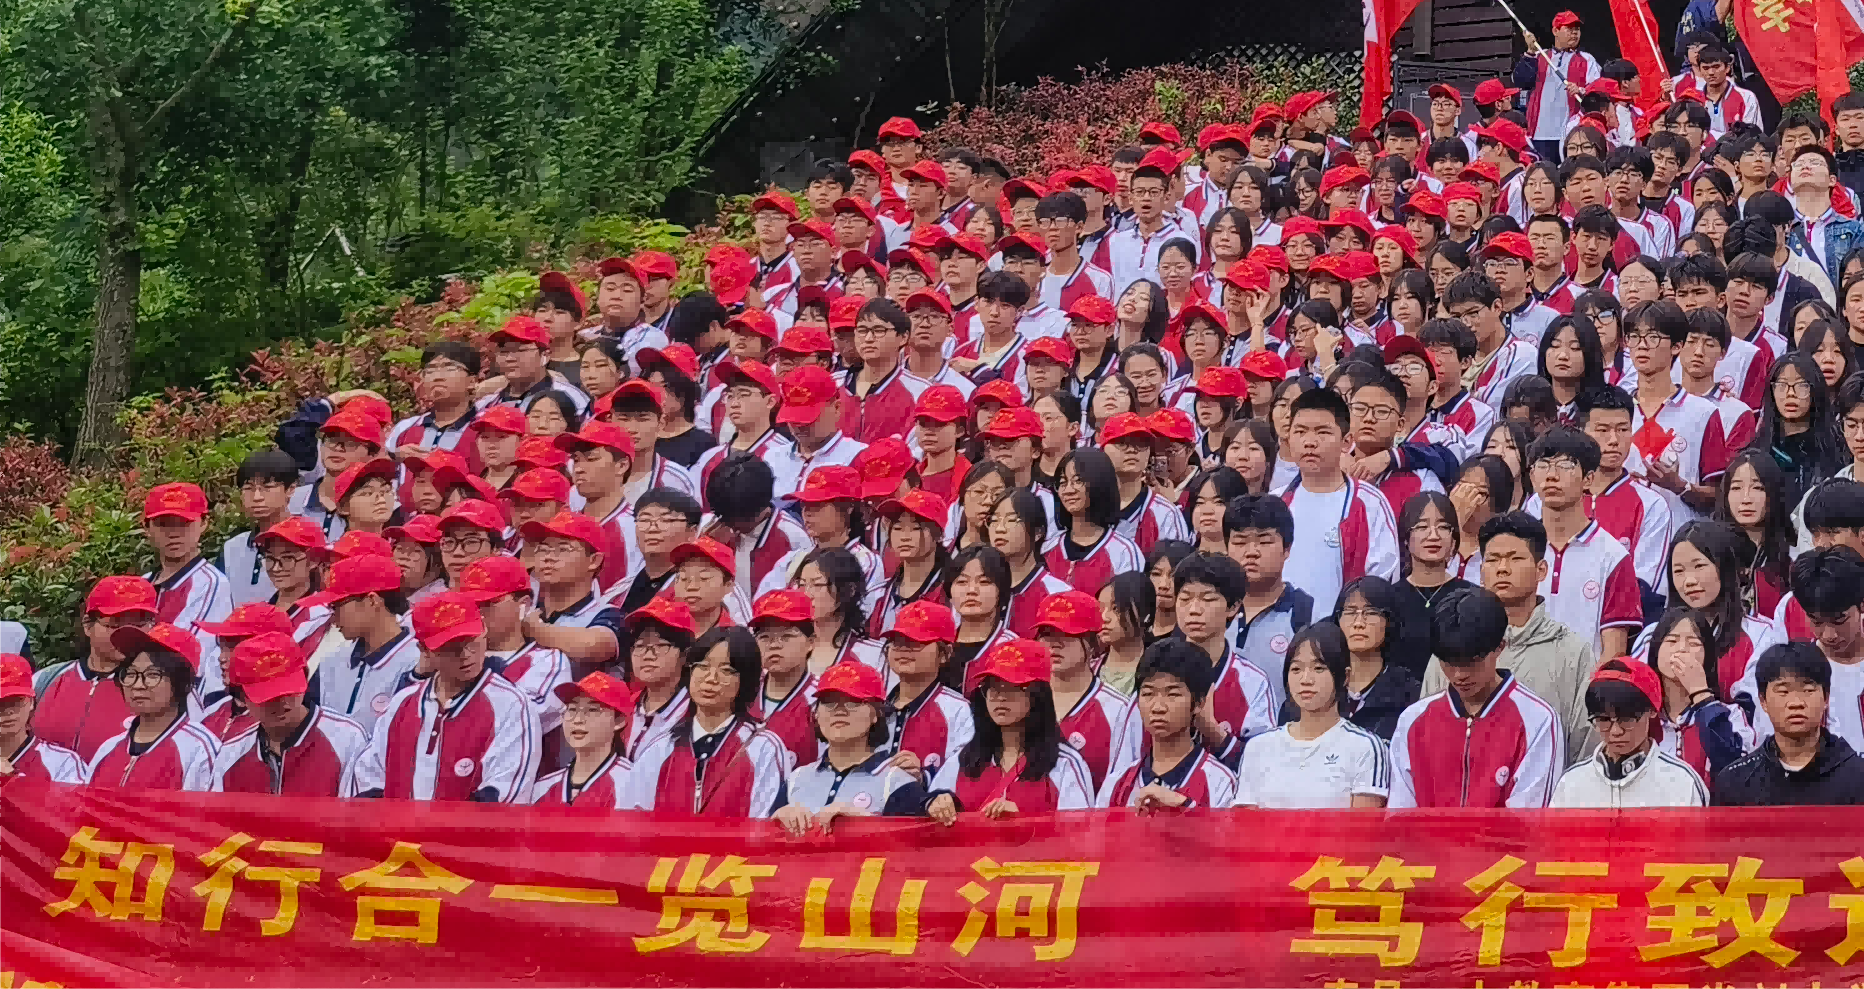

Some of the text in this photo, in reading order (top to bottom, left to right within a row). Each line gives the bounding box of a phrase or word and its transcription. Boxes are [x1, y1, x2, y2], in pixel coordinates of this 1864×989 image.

[45, 825, 1099, 962] 知行合一览山河
